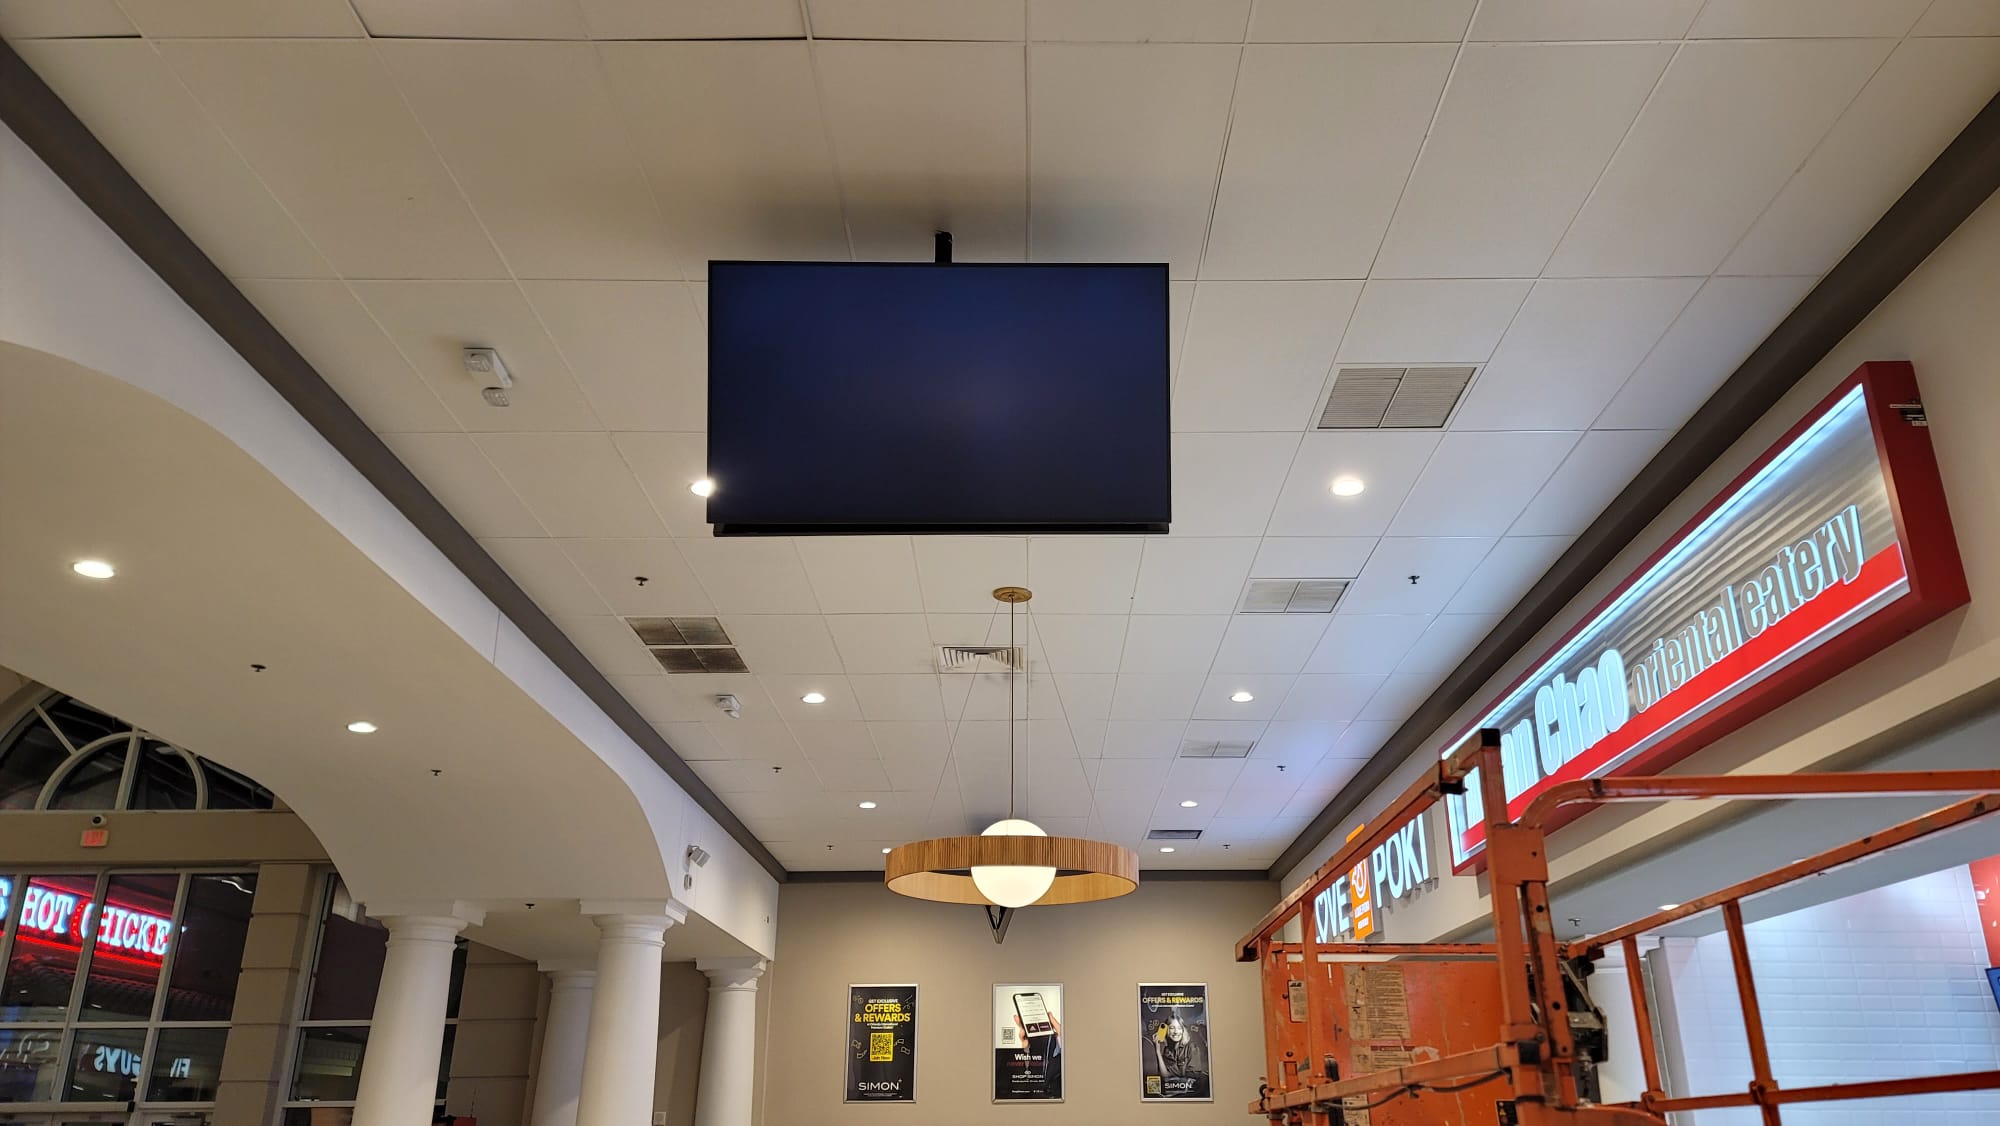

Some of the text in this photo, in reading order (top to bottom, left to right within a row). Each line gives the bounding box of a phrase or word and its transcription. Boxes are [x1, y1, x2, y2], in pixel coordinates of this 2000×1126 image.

[1534, 648, 1631, 776] Chao
[1631, 585, 1744, 713] oriental
[1740, 504, 1865, 638] eatery
[1314, 813, 1430, 944] OVE POKI
[20, 886, 76, 934] HOT
[1142, 996, 1167, 1004] OFFERS
[1172, 996, 1204, 1004] REWARDS
[864, 1003, 902, 1013] OFFERS
[854, 1012, 911, 1022] & REWARDS
[1014, 1053, 1031, 1061] Wish
[858, 1082, 899, 1091] SIMON
